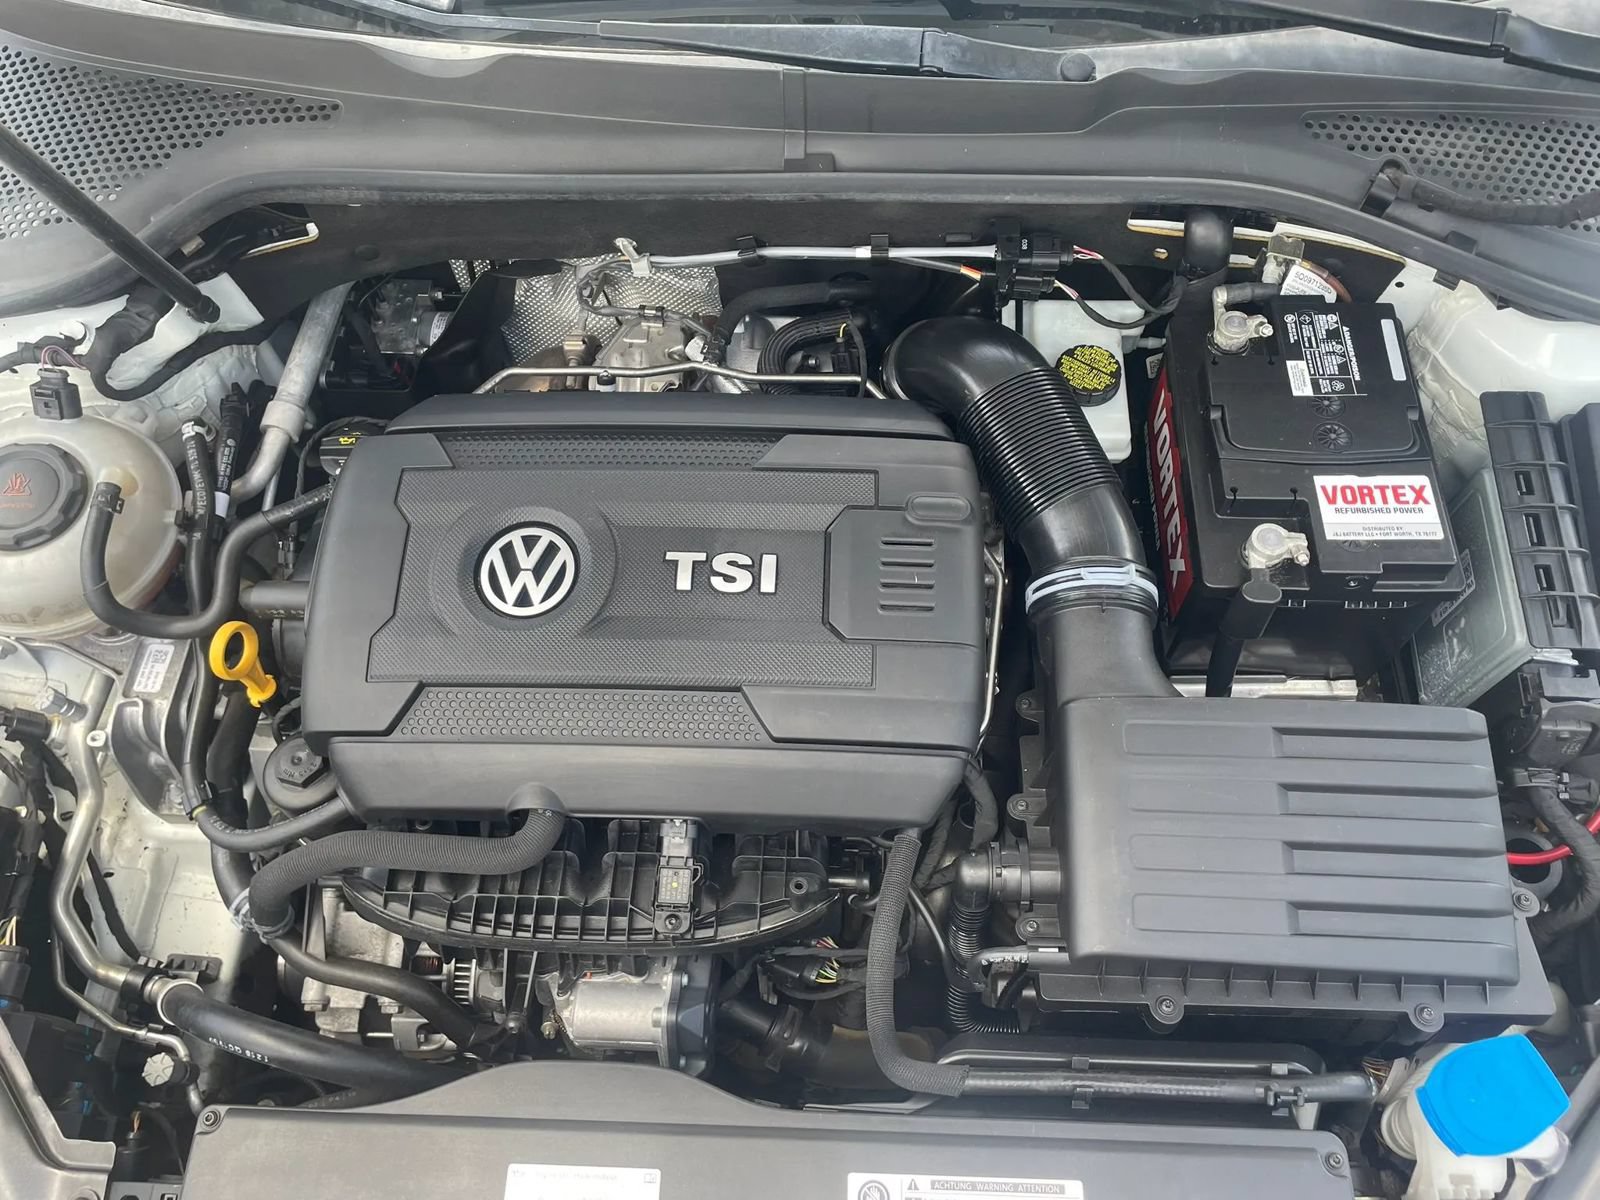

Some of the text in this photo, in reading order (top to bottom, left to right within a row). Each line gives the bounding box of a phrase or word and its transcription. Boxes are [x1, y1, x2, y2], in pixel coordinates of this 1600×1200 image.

[1153, 387, 1187, 591] VORTEX
[1320, 485, 1431, 505] VORTEX
[1335, 507, 1424, 515] REFURBISHED POWER
[665, 551, 778, 593] TSI
[933, 1181, 1060, 1194] ACHTUNG WARNING ATTENTION
